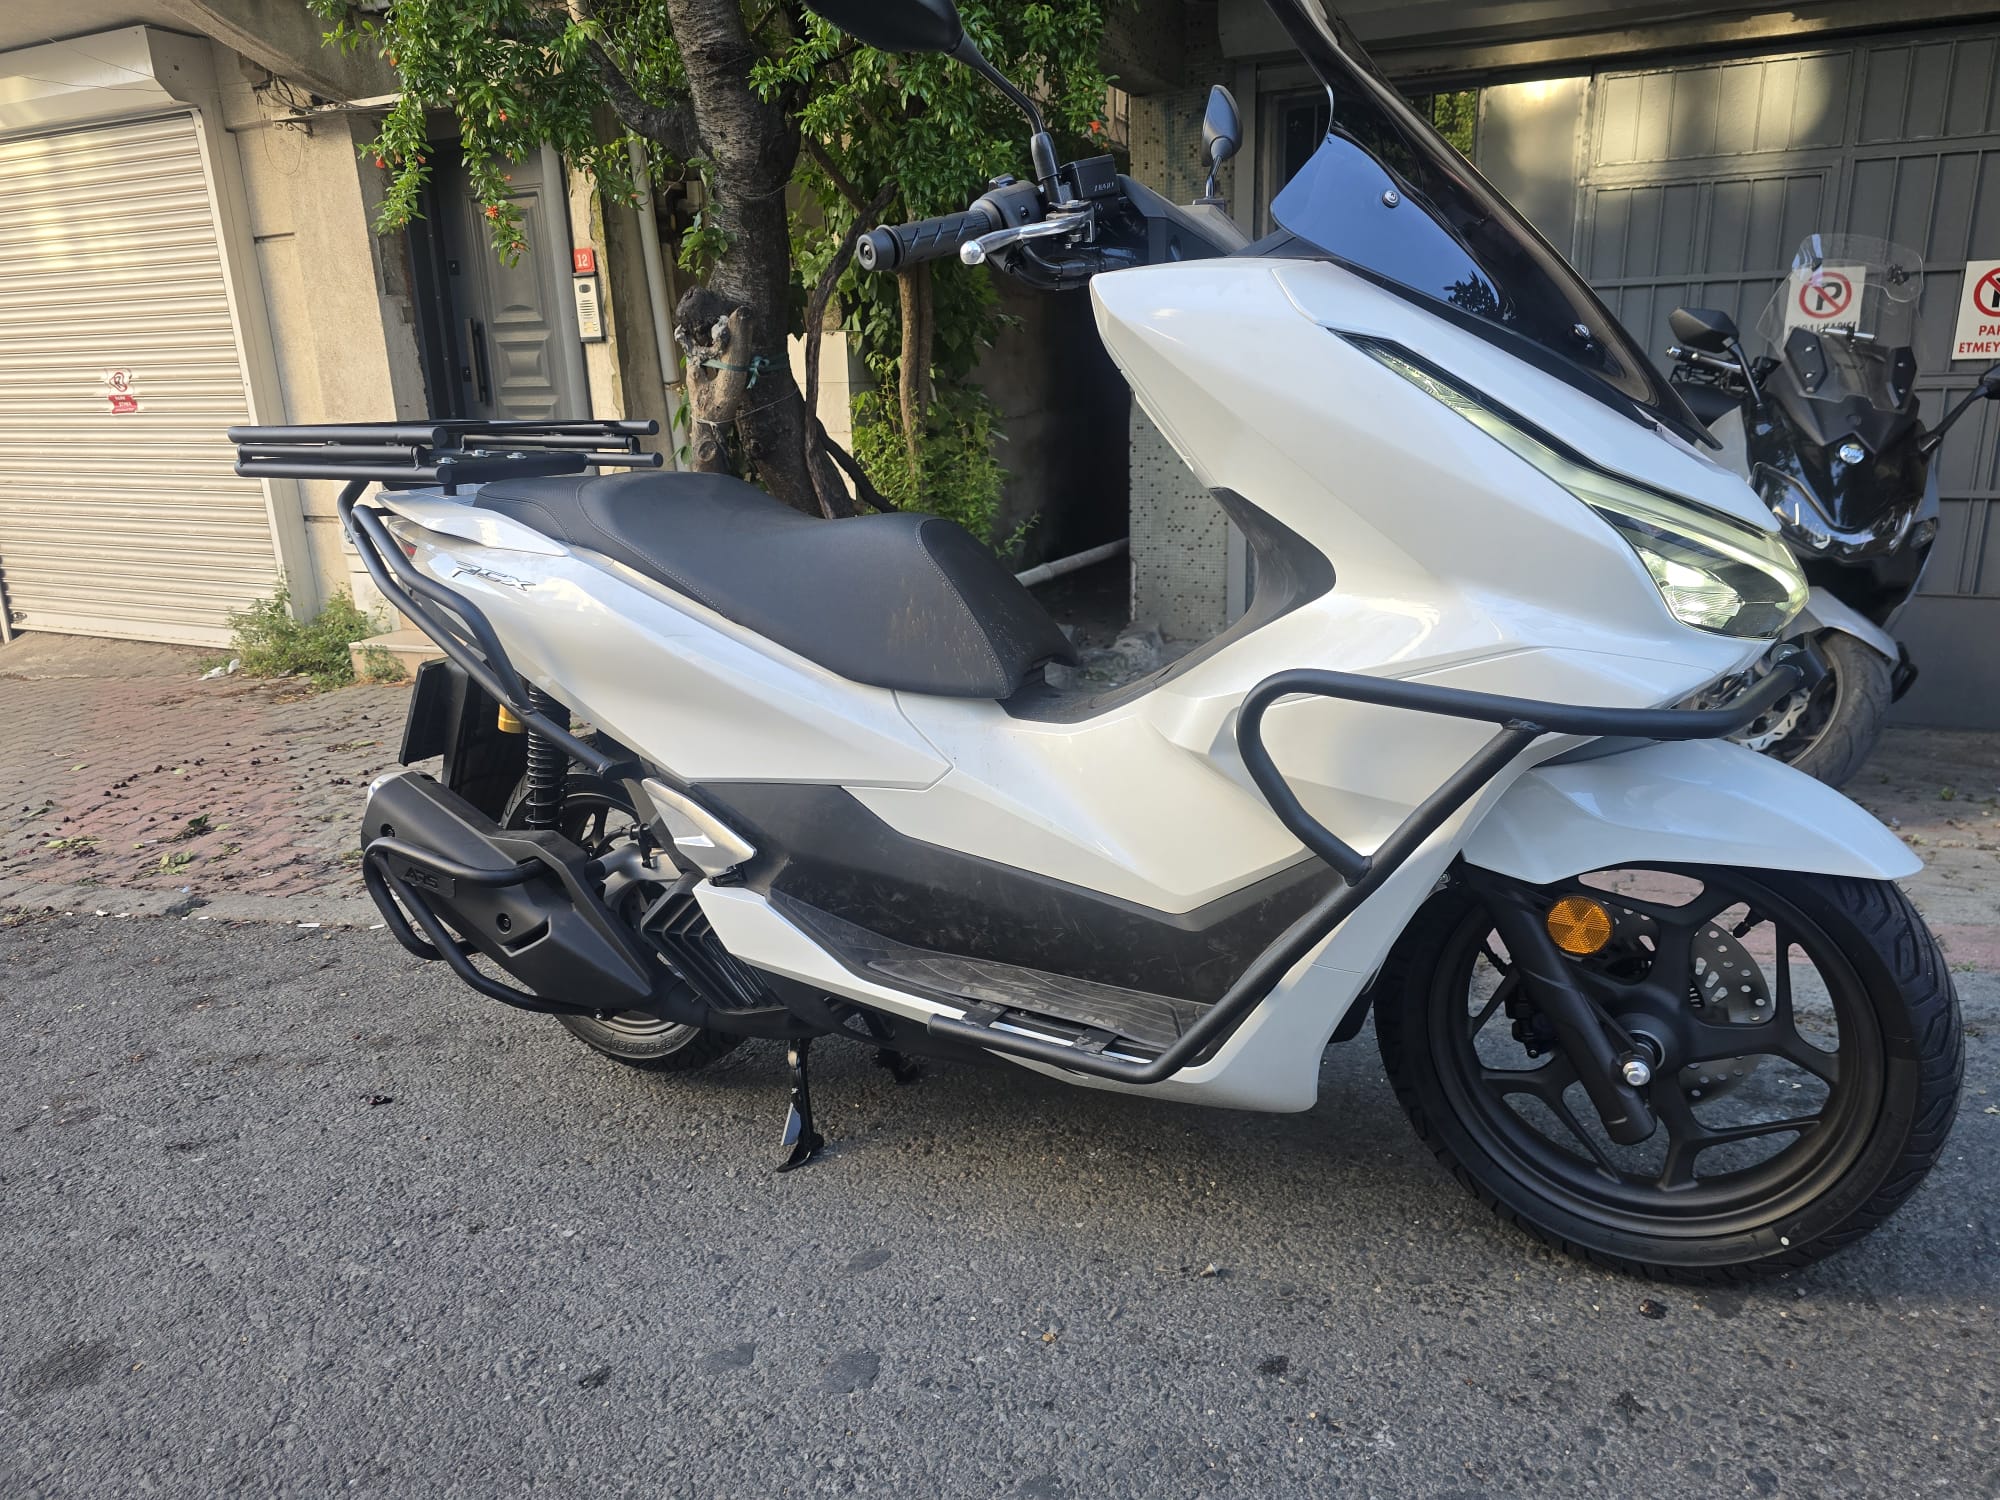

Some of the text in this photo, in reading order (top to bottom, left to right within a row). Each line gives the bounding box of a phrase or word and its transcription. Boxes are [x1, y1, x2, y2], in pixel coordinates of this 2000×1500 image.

[577, 254, 588, 267] 12
[1979, 325, 2000, 336] PA
[452, 561, 536, 591] PCX
